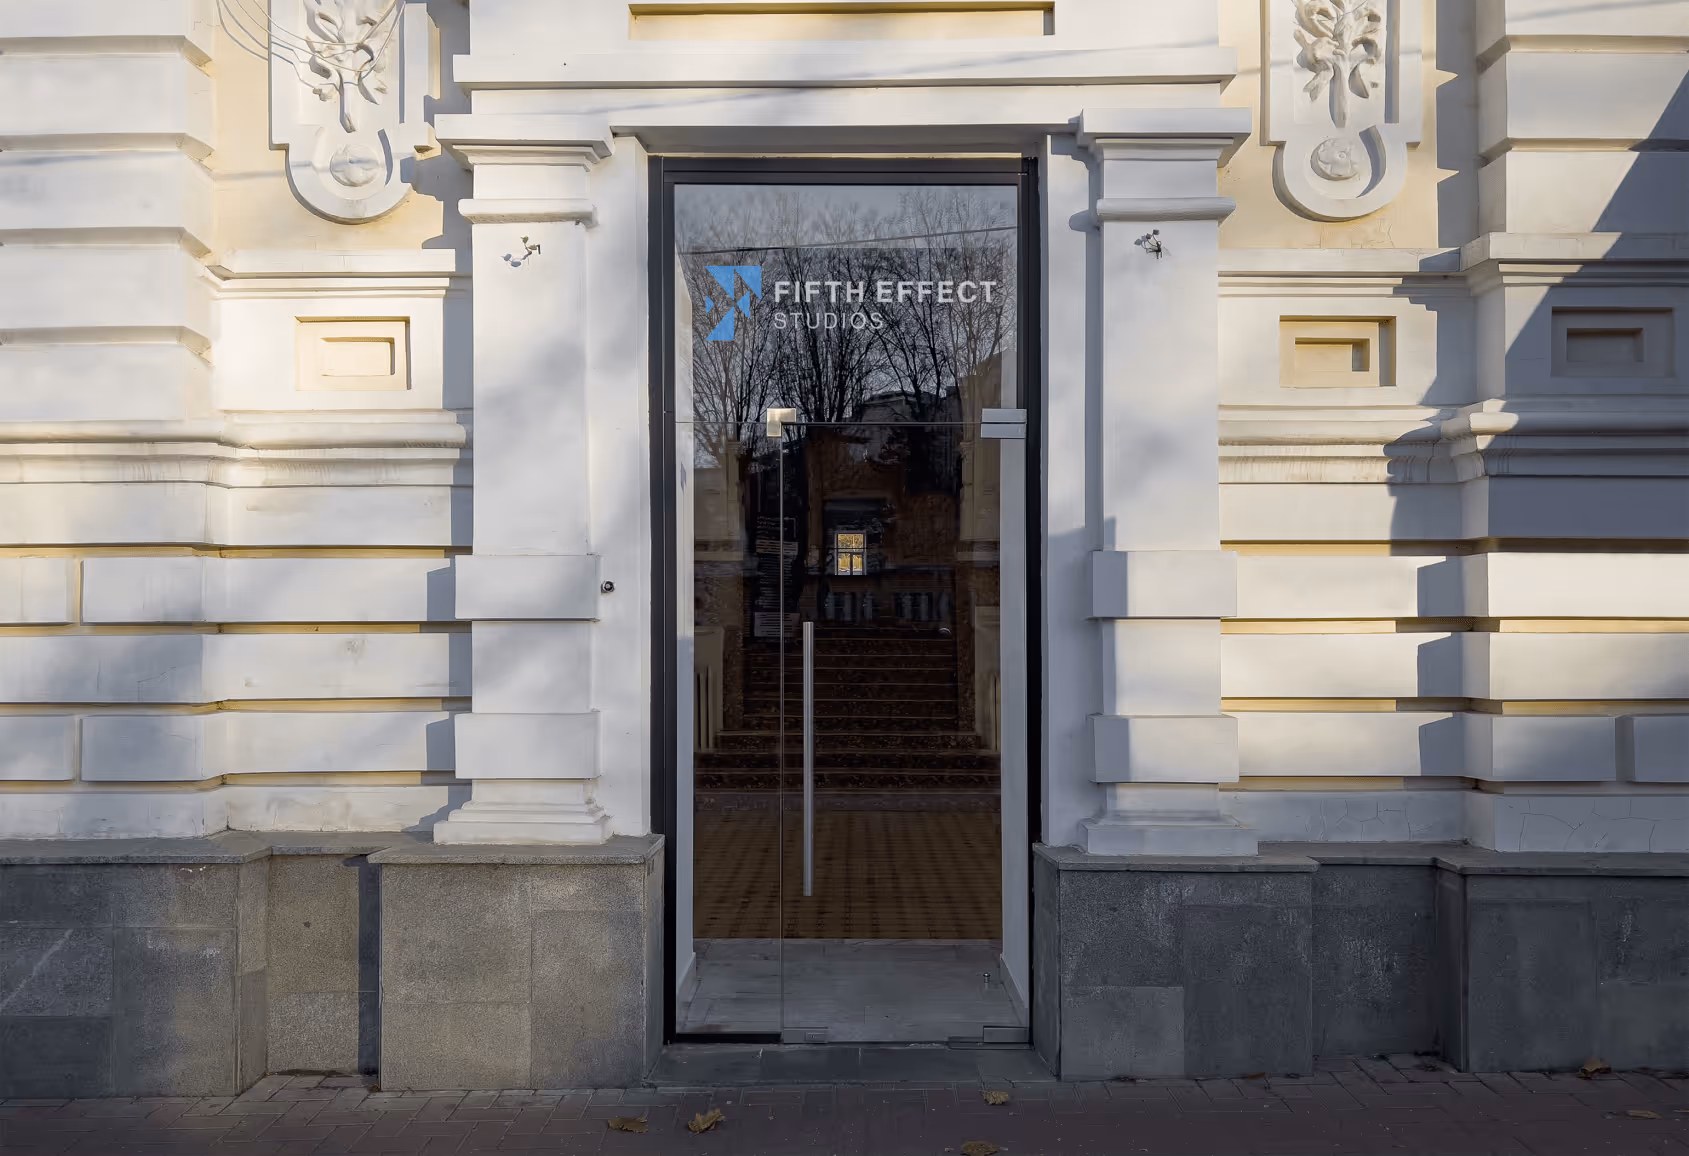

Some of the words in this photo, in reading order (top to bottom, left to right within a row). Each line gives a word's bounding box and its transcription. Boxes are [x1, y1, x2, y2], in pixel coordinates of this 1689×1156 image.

[774, 281, 864, 303] FIFTH
[877, 281, 997, 303] EFFECT
[774, 312, 884, 330] STUDIOS
